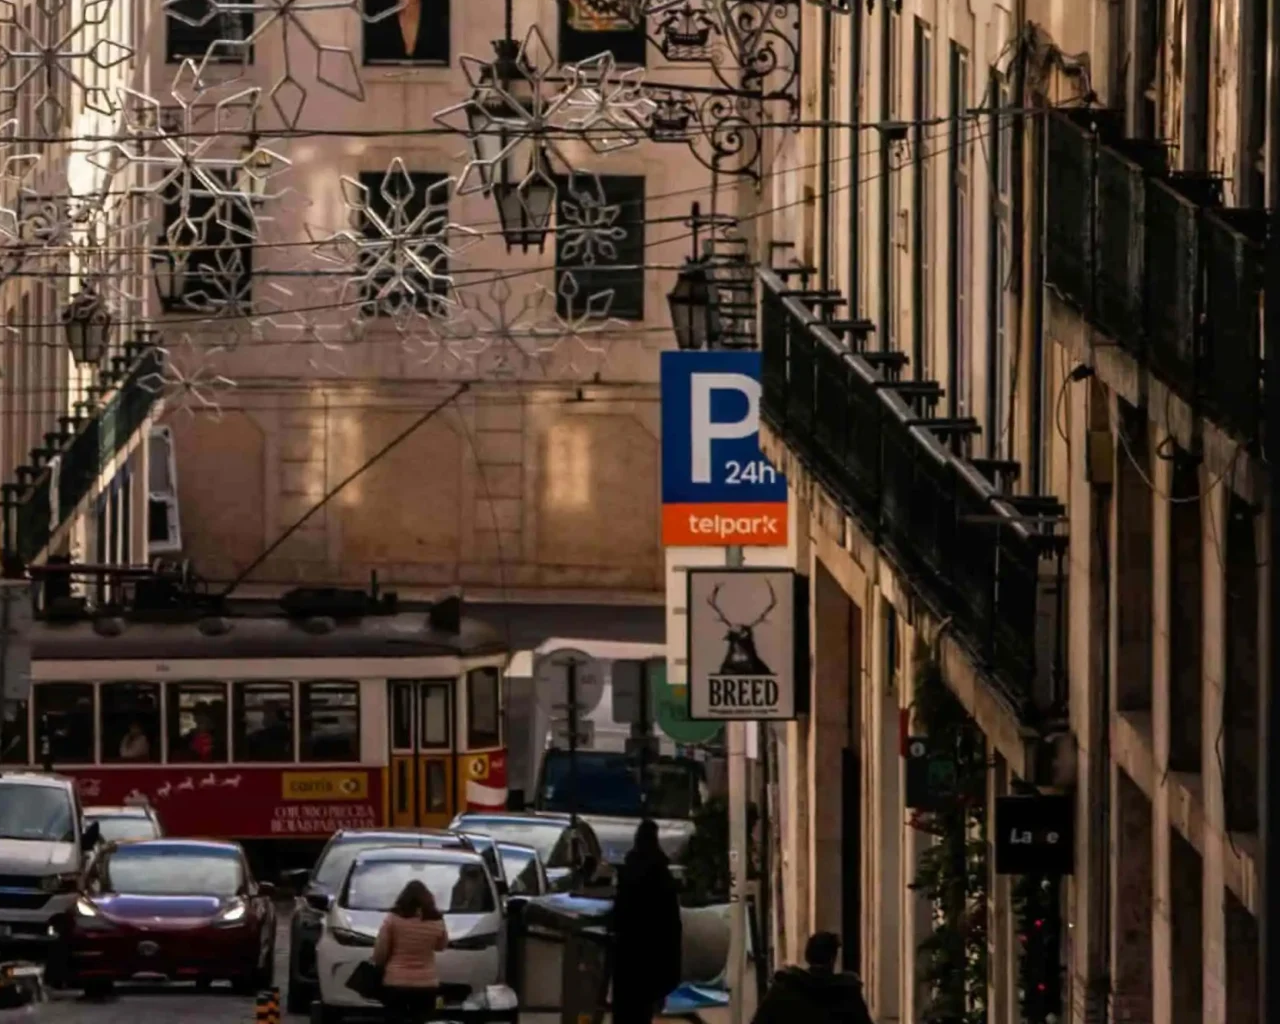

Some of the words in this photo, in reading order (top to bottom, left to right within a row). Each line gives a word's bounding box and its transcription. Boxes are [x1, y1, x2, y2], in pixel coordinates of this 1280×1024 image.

[691, 372, 762, 484] P
[725, 460, 775, 484] 24h
[689, 514, 778, 538] telpark
[709, 679, 779, 706] BREED
